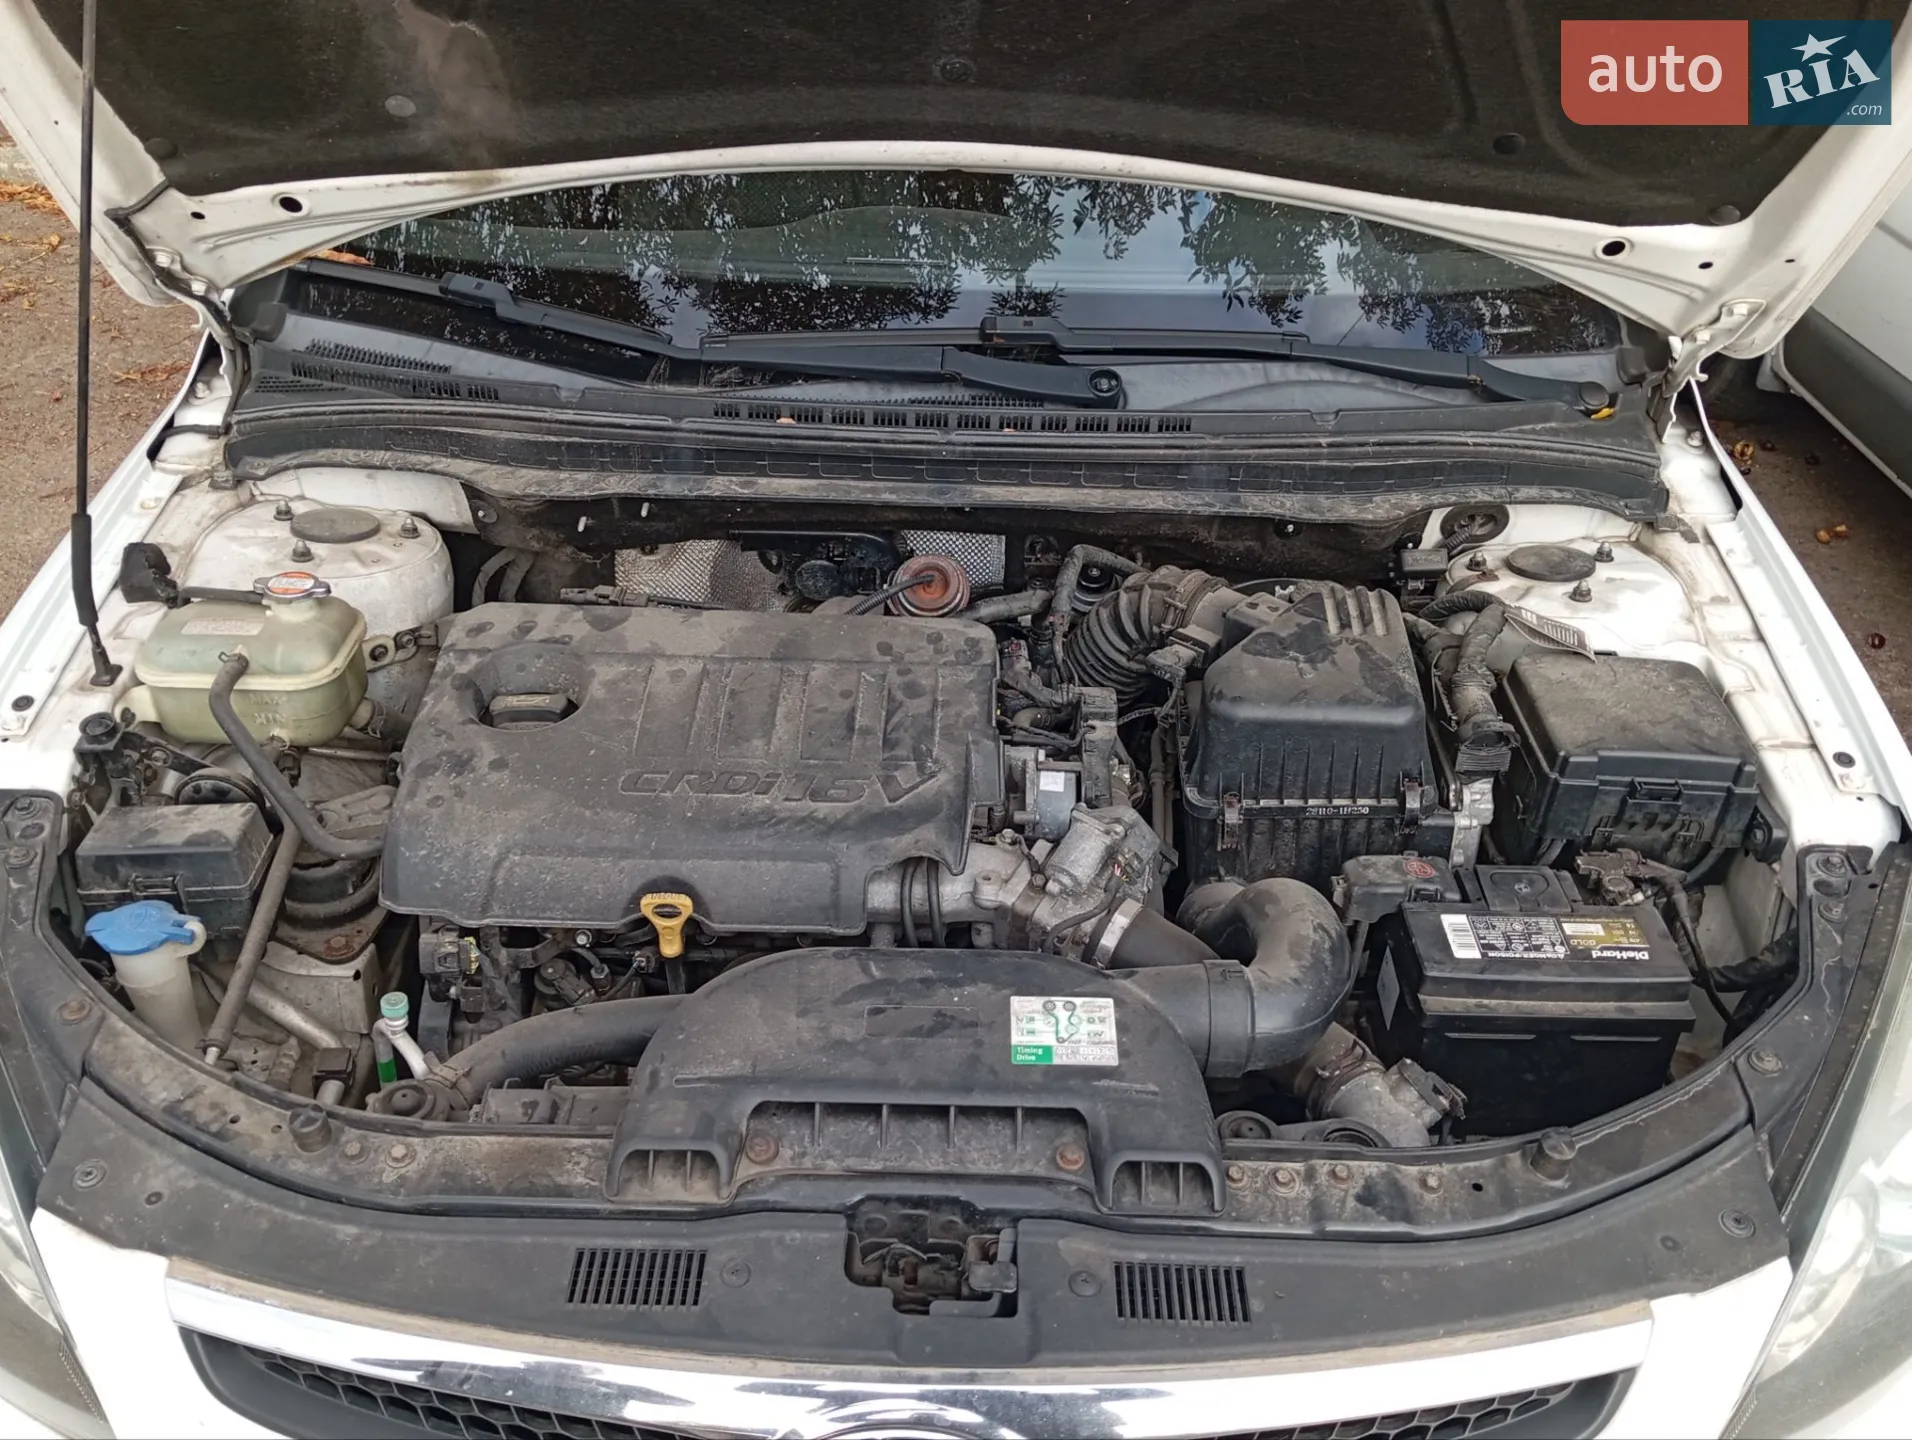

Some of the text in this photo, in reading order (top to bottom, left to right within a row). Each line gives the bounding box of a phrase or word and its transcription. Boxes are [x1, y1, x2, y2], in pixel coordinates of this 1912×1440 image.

[1570, 939, 1597, 947] GOLD
[1592, 950, 1650, 961] DieHard
[1016, 1047, 1044, 1055] Timing
